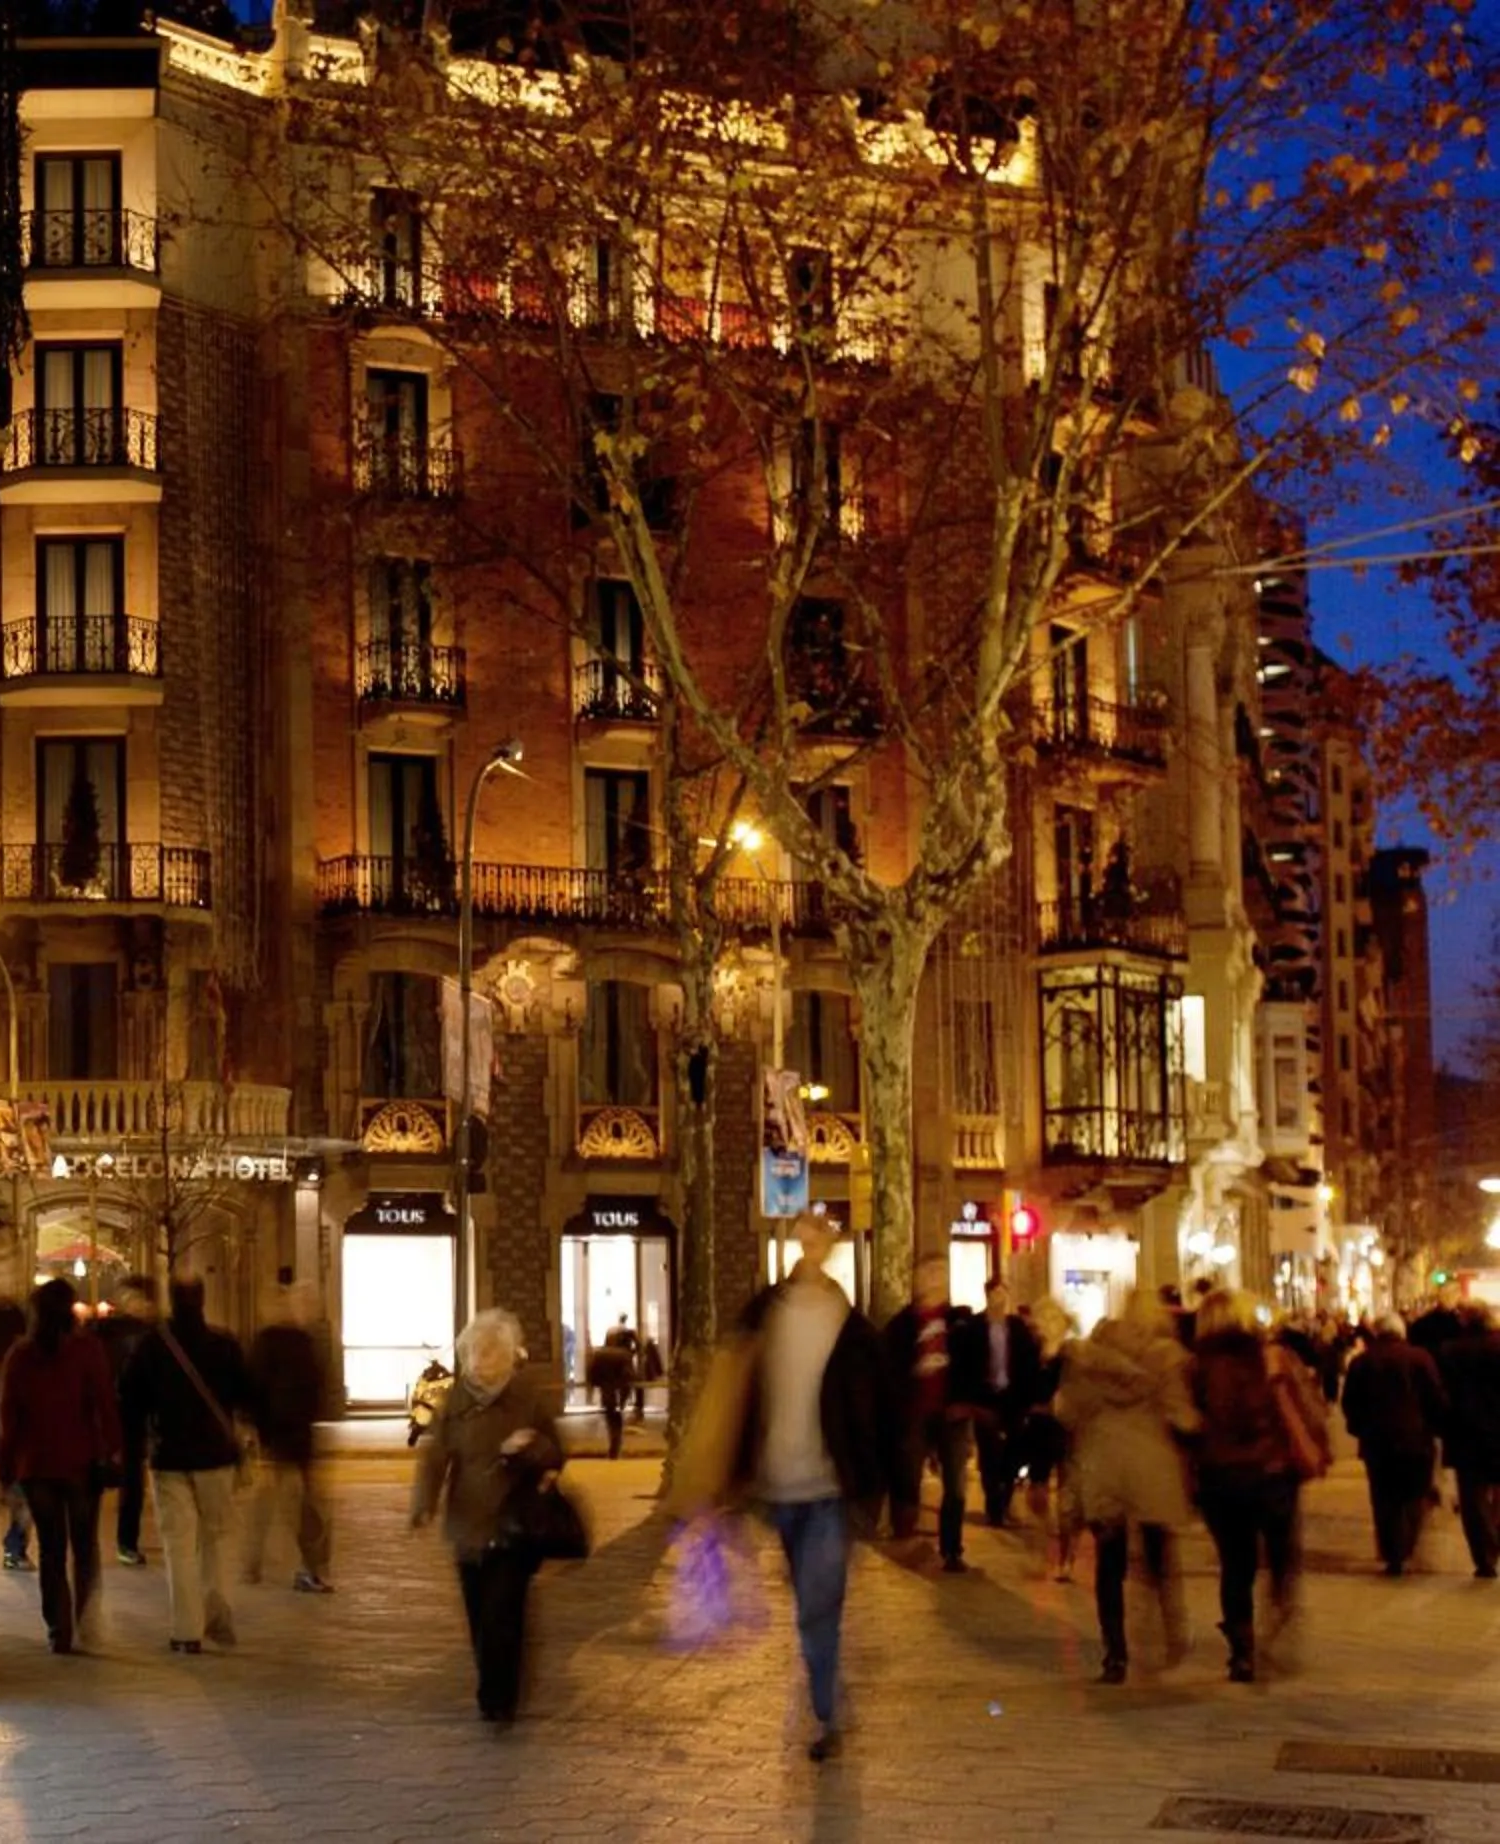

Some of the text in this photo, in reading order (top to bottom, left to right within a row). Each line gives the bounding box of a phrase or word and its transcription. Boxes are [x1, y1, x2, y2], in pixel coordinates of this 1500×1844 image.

[216, 1155, 293, 1181] HOTEL
[376, 1207, 426, 1224] TOUS
[592, 1211, 639, 1227] TOUS
